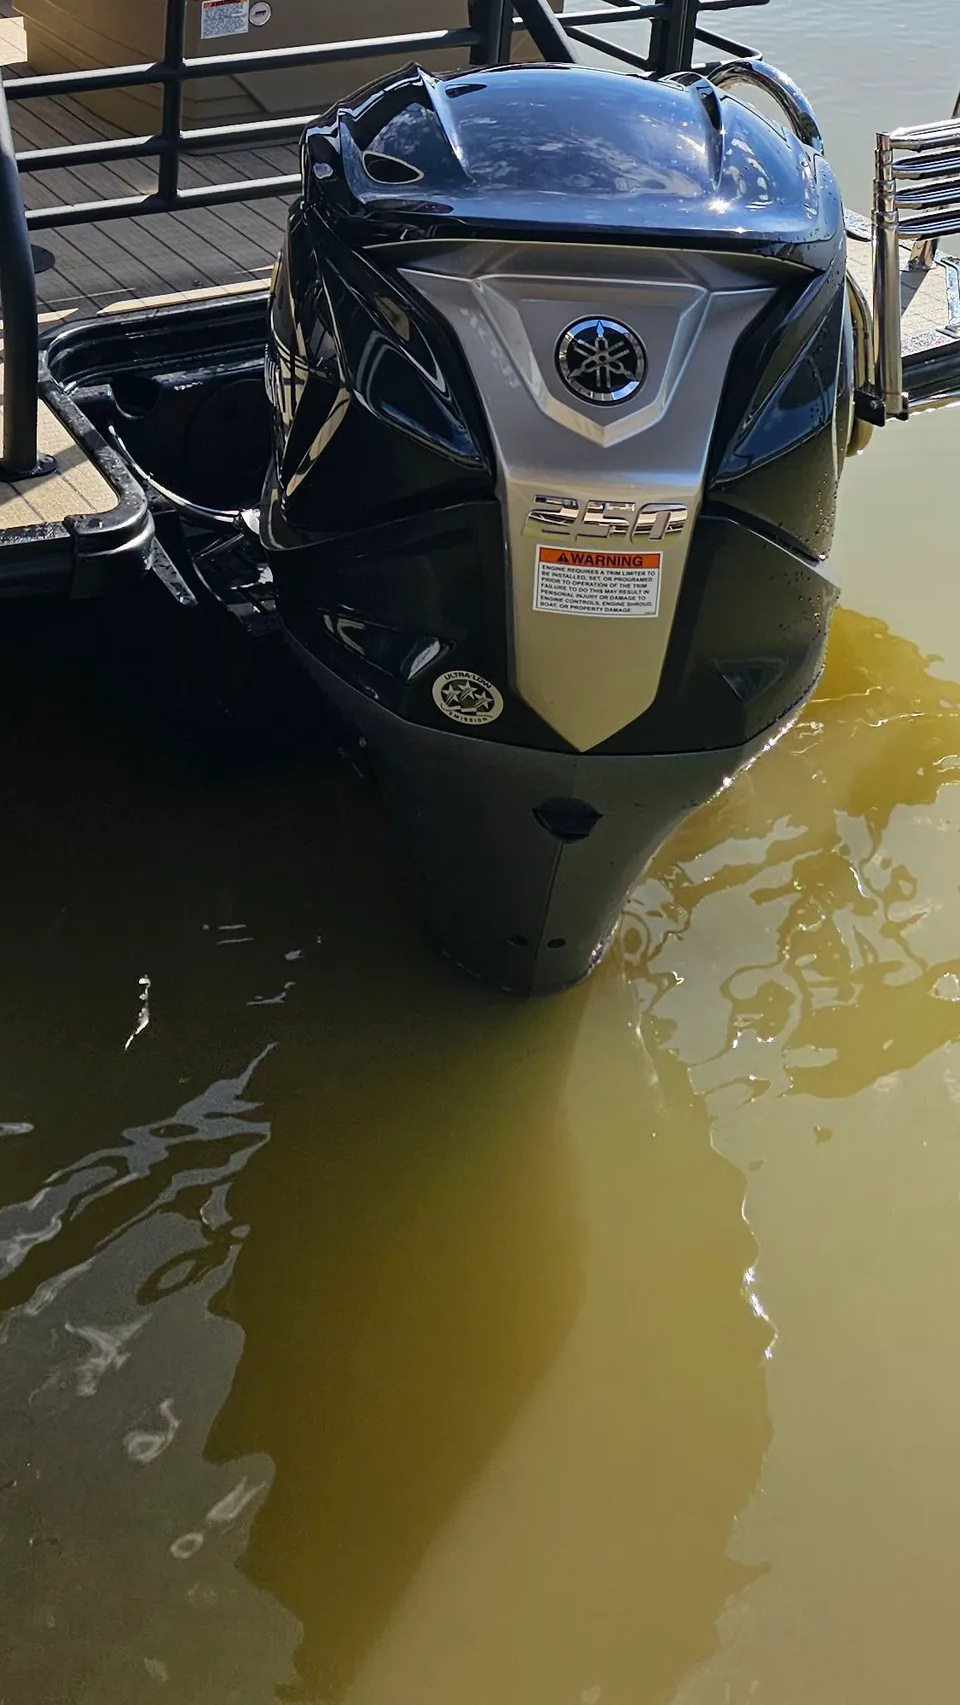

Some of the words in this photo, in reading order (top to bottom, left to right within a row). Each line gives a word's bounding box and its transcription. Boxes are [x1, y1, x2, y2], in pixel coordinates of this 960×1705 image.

[522, 495, 688, 543] 250
[571, 552, 643, 567] WARNING
[449, 711, 488, 723] EMISSION
